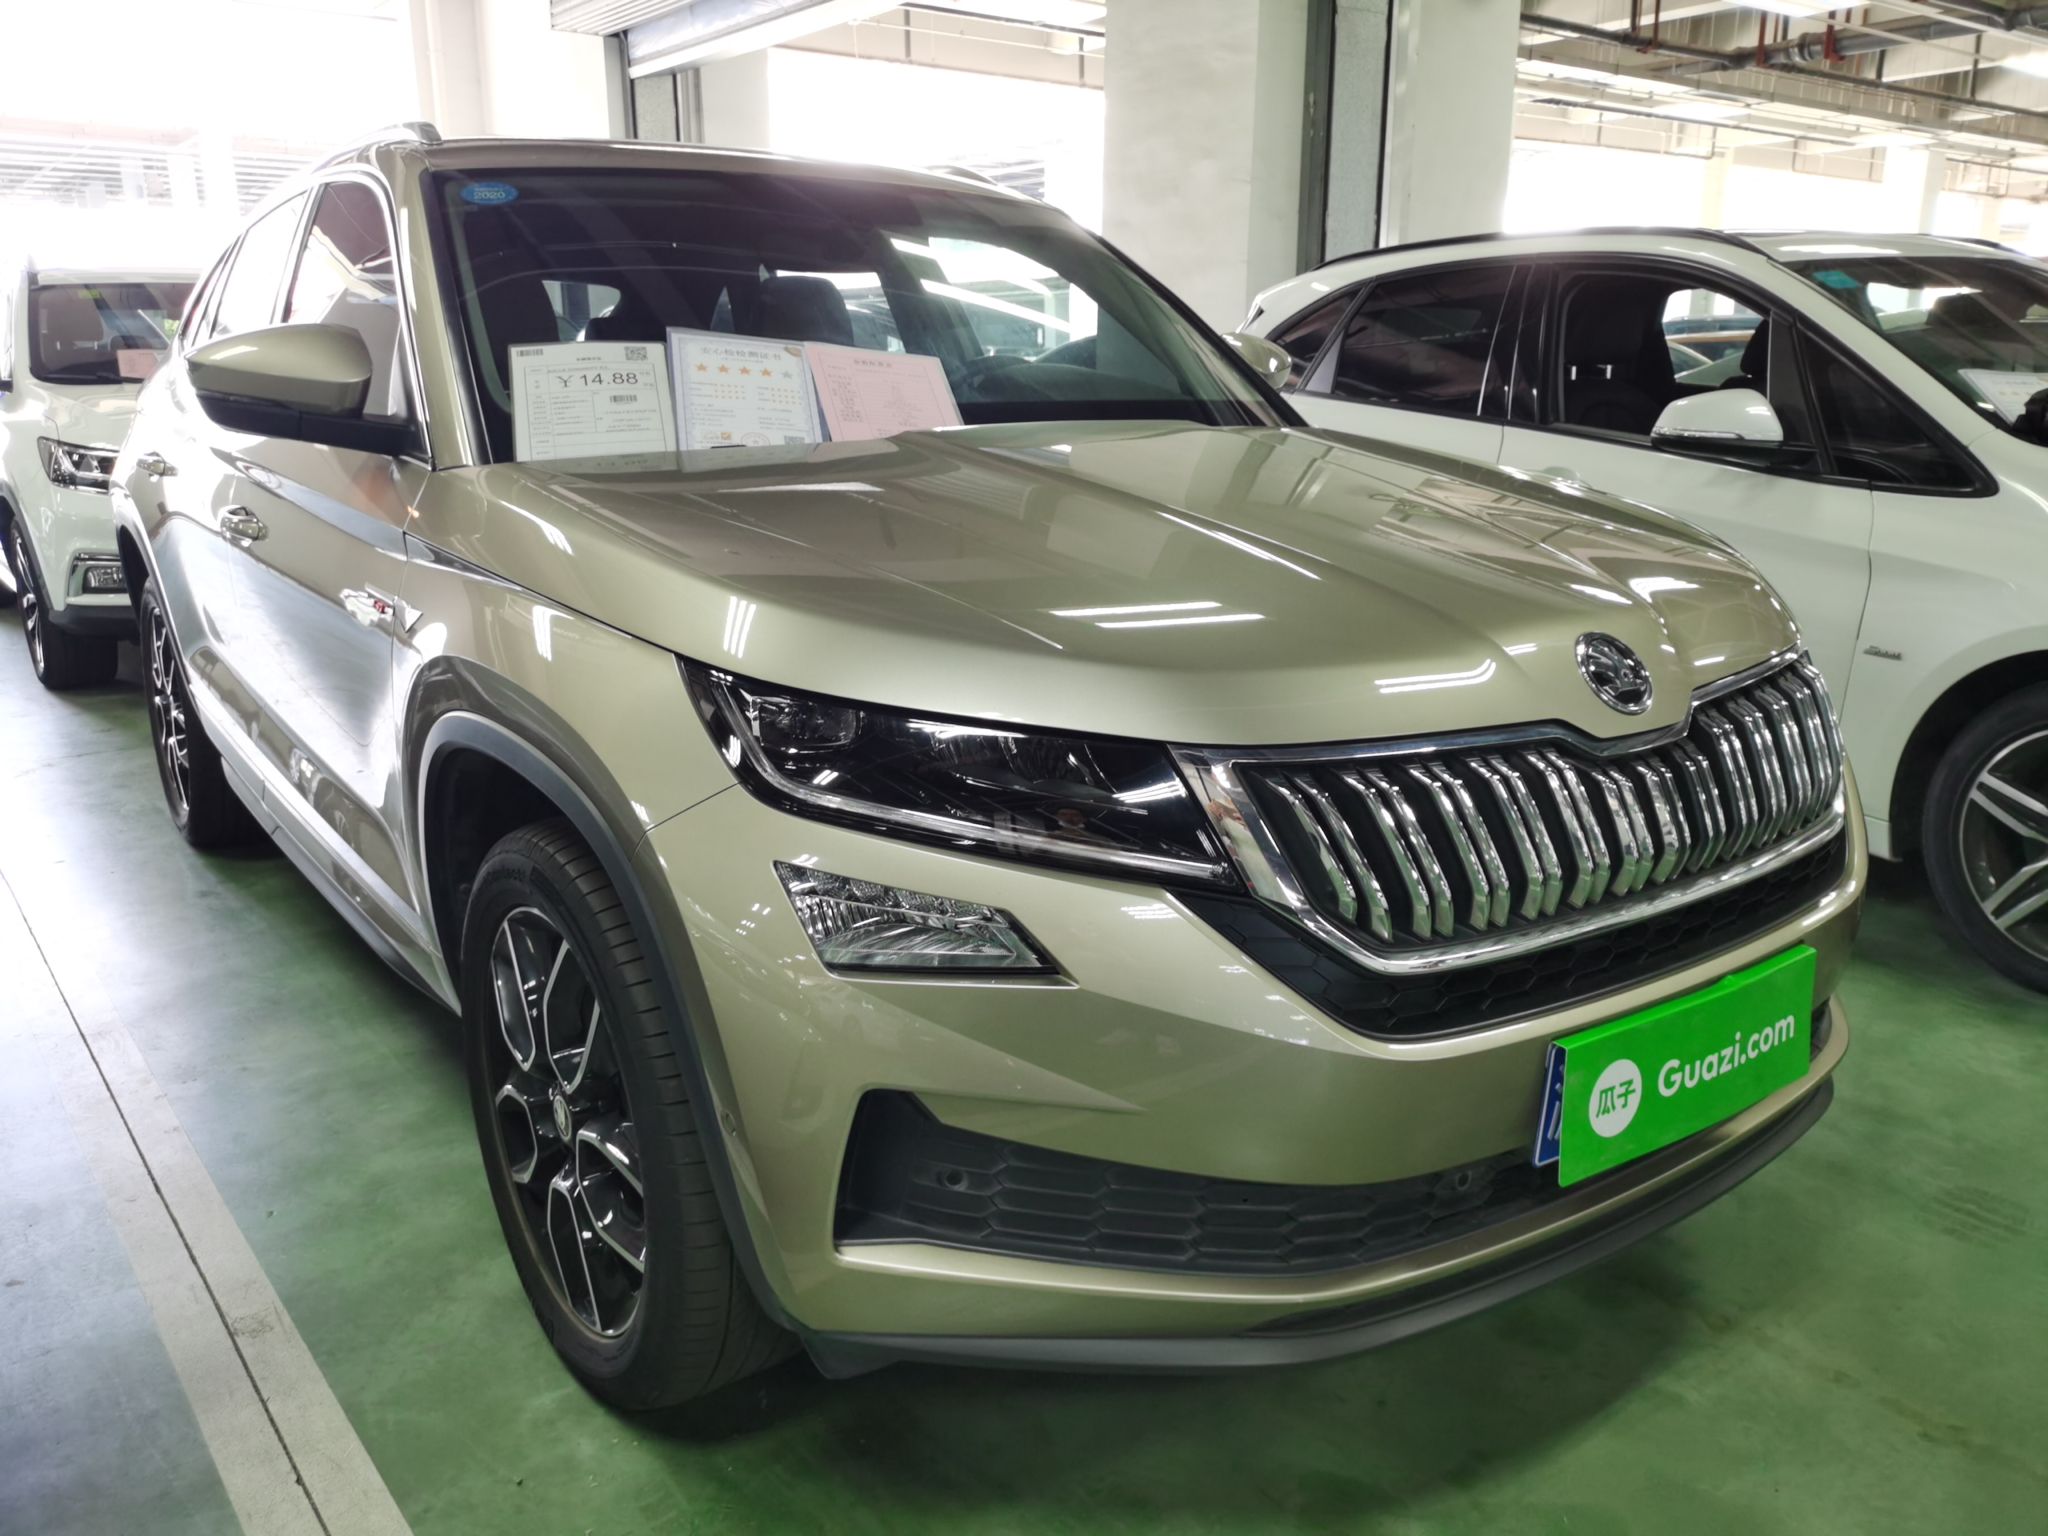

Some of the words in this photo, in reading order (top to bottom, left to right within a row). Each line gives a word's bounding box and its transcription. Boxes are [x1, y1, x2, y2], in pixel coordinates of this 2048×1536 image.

[473, 191, 506, 200] 2020
[1658, 1014, 1796, 1098] Guazi.com
[1596, 1078, 1637, 1119] 瓜子
